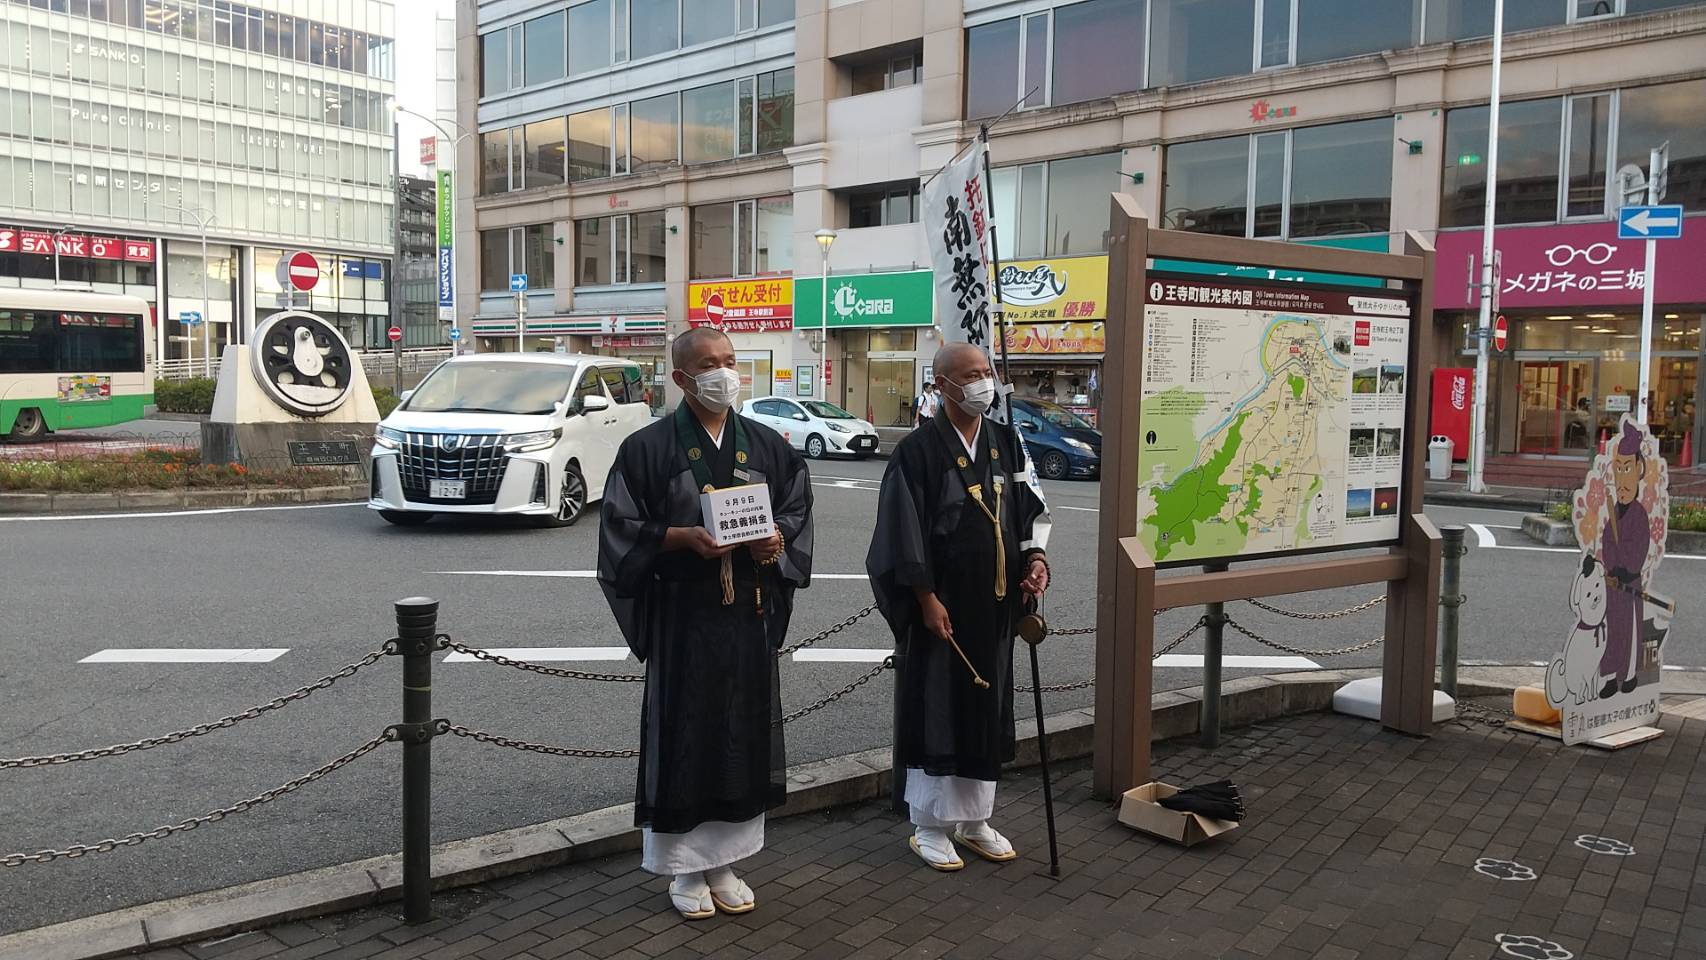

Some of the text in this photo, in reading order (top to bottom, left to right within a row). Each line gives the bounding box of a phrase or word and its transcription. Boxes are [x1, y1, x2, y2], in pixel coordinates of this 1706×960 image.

[89, 45, 141, 64] SANKO
[71, 108, 173, 132] Pure Clinic
[22, 237, 106, 257] SANKO
[1503, 269, 1647, 294] メガネの三城
[1165, 285, 1253, 306] 王寺町観光案内図
[1263, 291, 1274, 299] Town
[1275, 292, 1299, 300] Information
[1300, 293, 1310, 302] Map
[1031, 309, 1057, 318] 決定戦
[1063, 301, 1096, 317] 優勝
[719, 513, 768, 531] 救急義捐金
